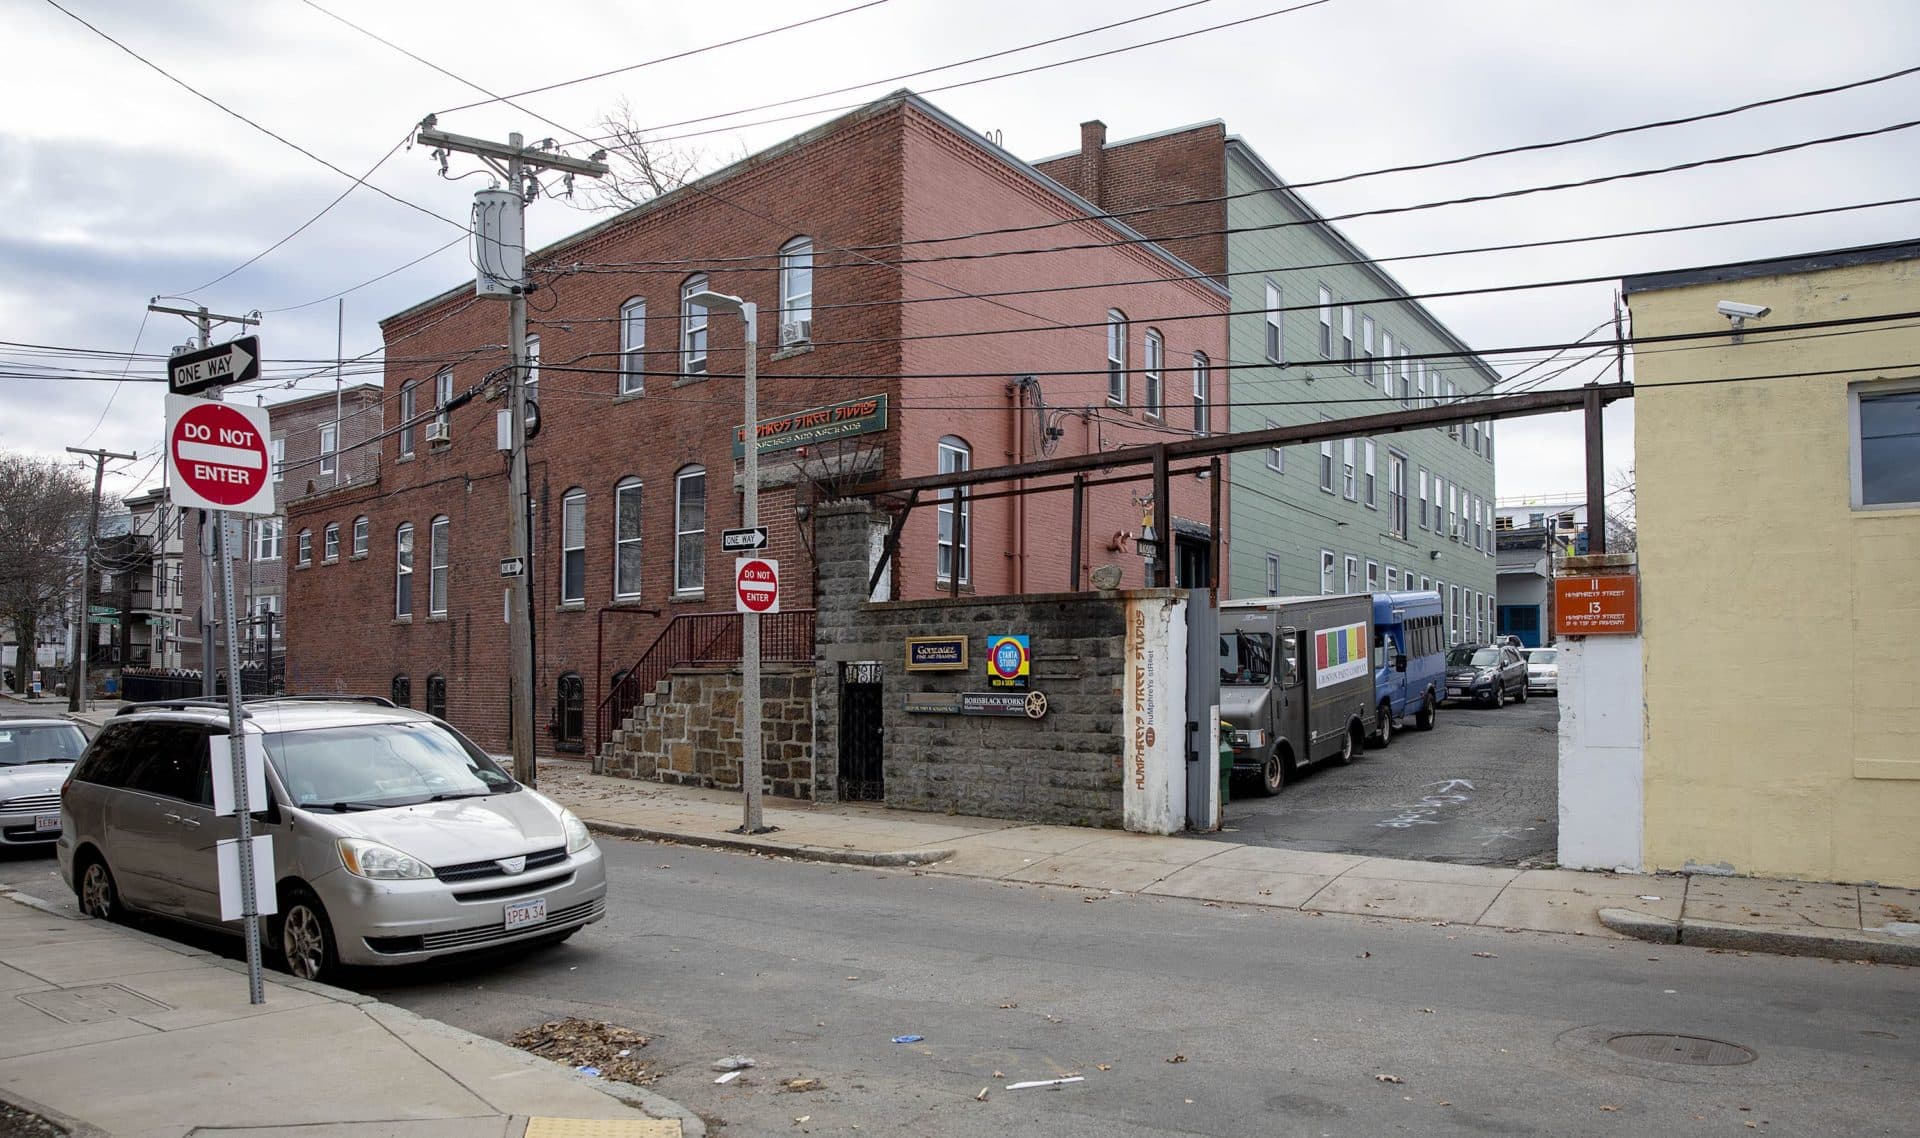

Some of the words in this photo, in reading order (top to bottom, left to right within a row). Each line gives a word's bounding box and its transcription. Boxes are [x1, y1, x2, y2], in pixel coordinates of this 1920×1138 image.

[178, 364, 200, 385] ONE
[207, 355, 232, 376] WAY
[737, 420, 792, 441] HPHREYS
[795, 409, 832, 428] STREET
[835, 400, 877, 420] STUDIOS
[184, 423, 211, 440] DO
[219, 428, 254, 447] NOT
[794, 432, 813, 442] AND
[194, 464, 250, 485] ENTER
[726, 535, 739, 545] ONE
[742, 534, 755, 544] WAY
[744, 570, 755, 579] DO
[757, 571, 770, 580] NOT
[1591, 579, 1598, 590] 11
[746, 592, 769, 602] ENTER
[1589, 601, 1601, 613] 13
[1135, 609, 1145, 661] STUDIOS
[998, 650, 1018, 659] CYANTA
[999, 659, 1017, 667] STUDIO
[1135, 665, 1145, 712] STREET
[964, 697, 1001, 705] BORISBLACK
[1002, 697, 1024, 705] WORKS
[1135, 716, 1145, 790] HUMPHREYS
[507, 908, 530, 924] 1PEA
[532, 905, 544, 918] 34
